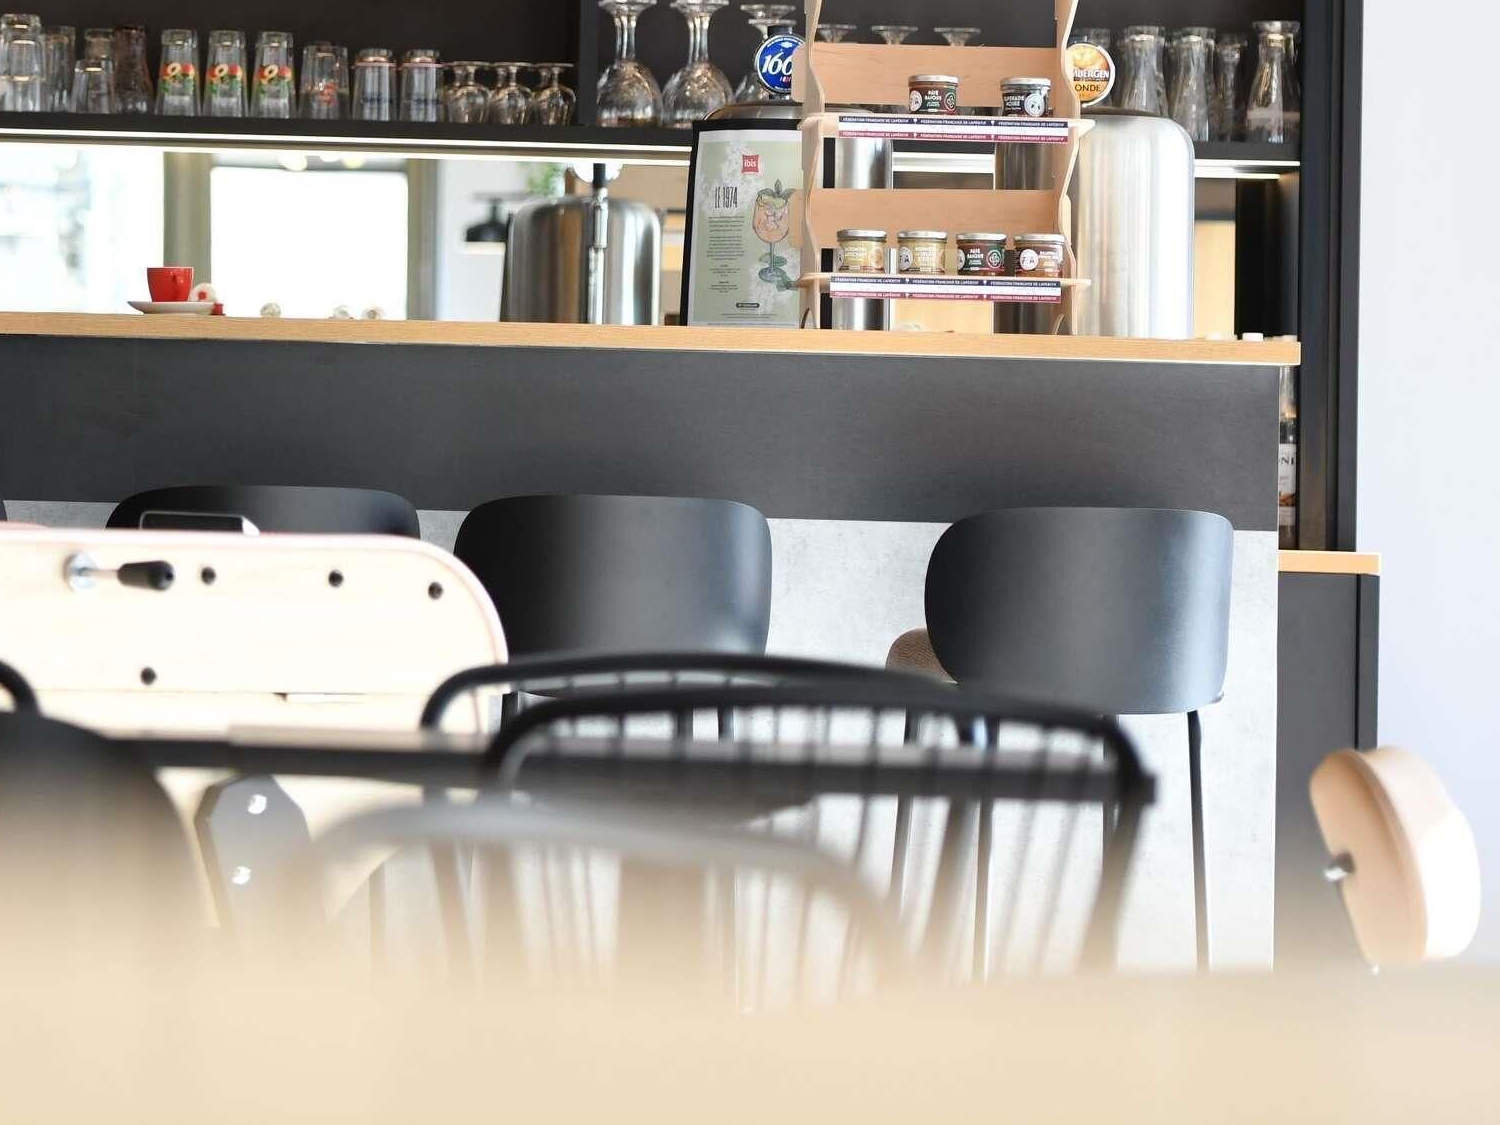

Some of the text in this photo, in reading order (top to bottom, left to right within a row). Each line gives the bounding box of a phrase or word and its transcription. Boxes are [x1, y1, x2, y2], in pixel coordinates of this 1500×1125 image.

[762, 51, 793, 75] 166
[1075, 83, 1101, 92] ONDE
[743, 159, 757, 167] ibis
[714, 186, 738, 208] LE 1974
